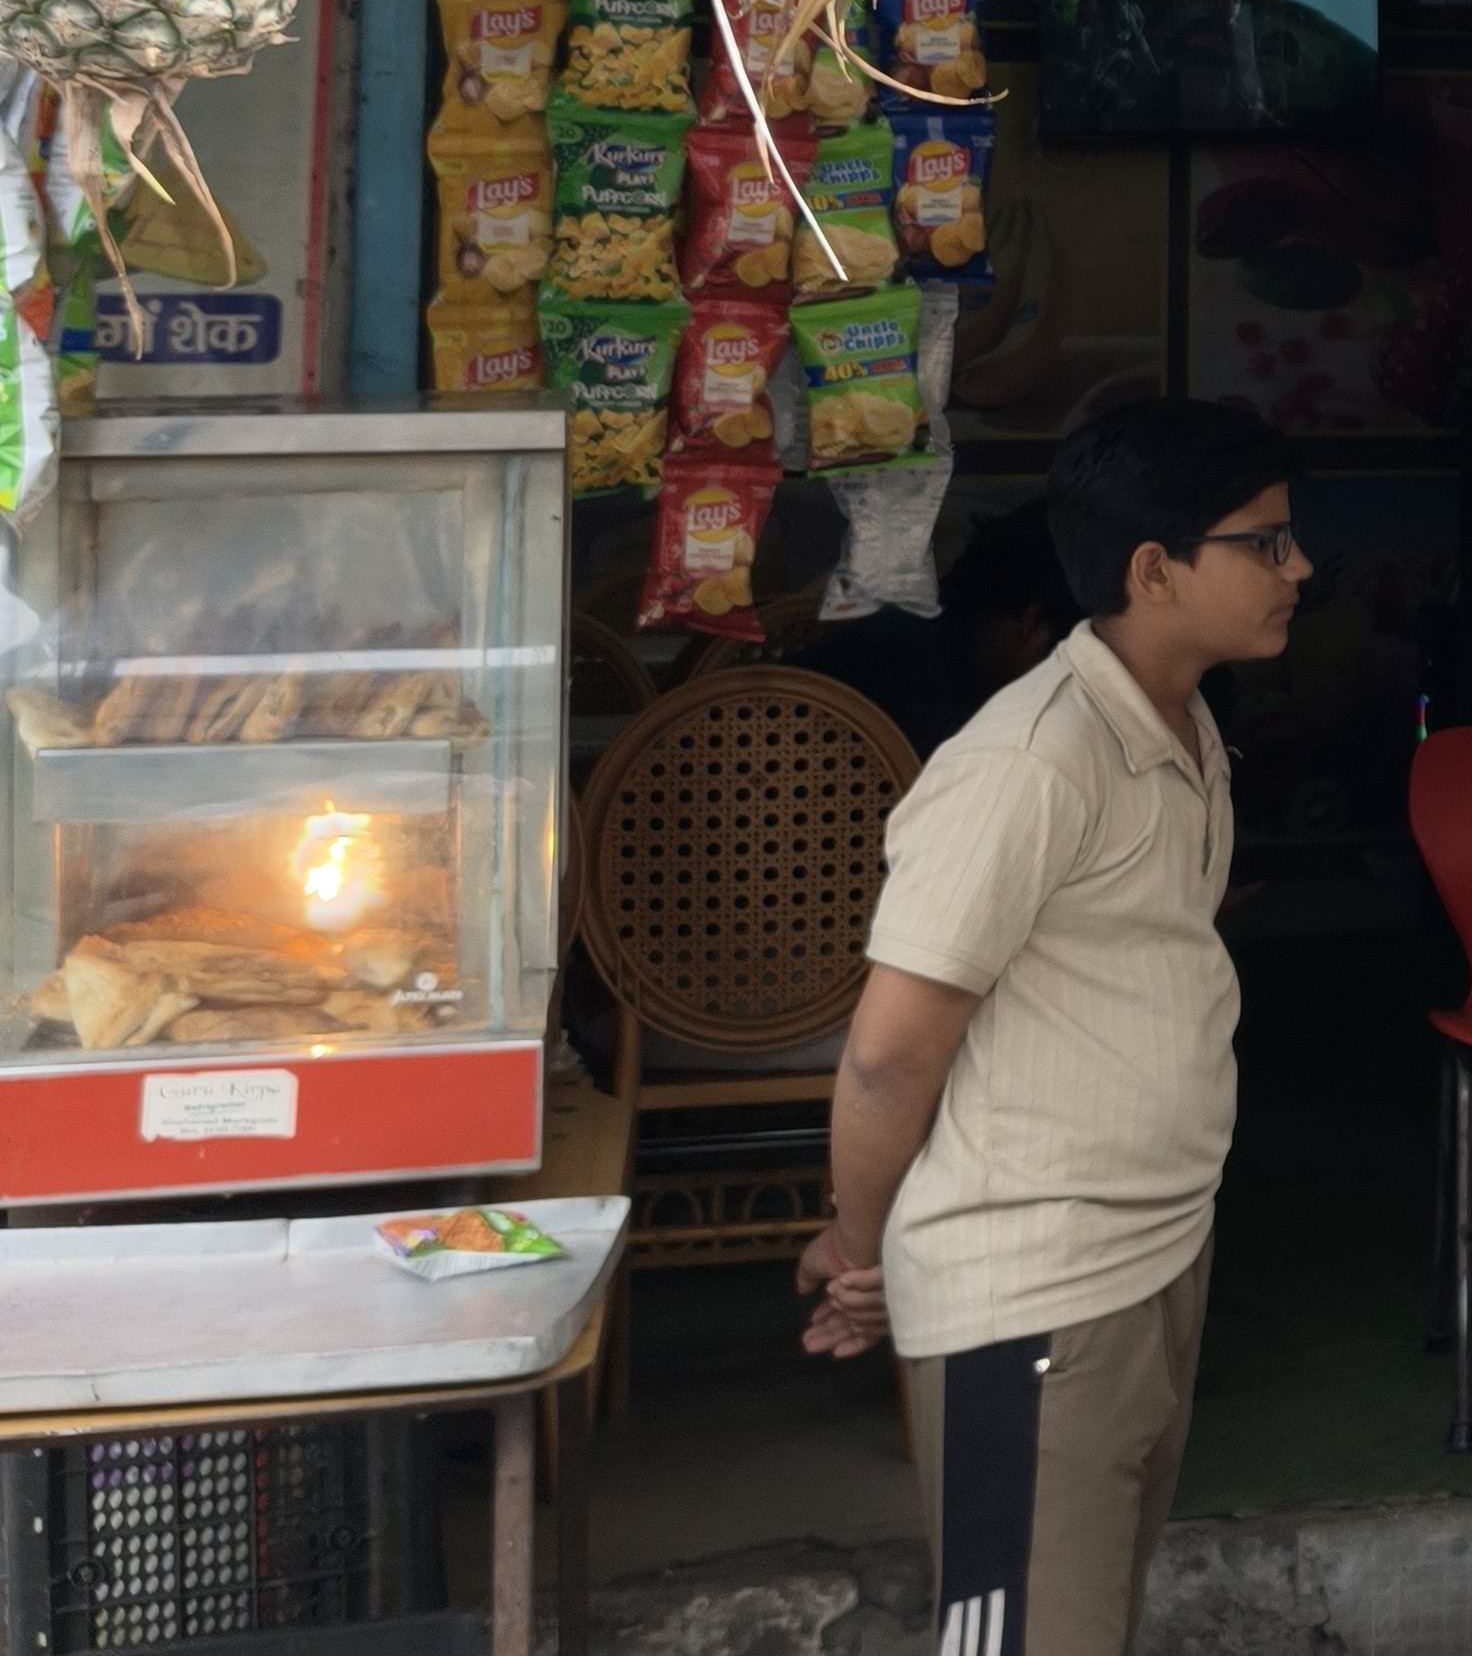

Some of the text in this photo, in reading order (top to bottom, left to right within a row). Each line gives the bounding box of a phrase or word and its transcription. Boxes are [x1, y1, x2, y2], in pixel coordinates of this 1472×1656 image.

[480, 8, 536, 38] Lay's
[913, 147, 966, 181] Lay's
[476, 173, 534, 210] Lay's
[168, 301, 264, 354] शेक
[847, 321, 898, 336] Uncle
[706, 337, 759, 365] Lay's
[687, 495, 742, 531] Lay's
